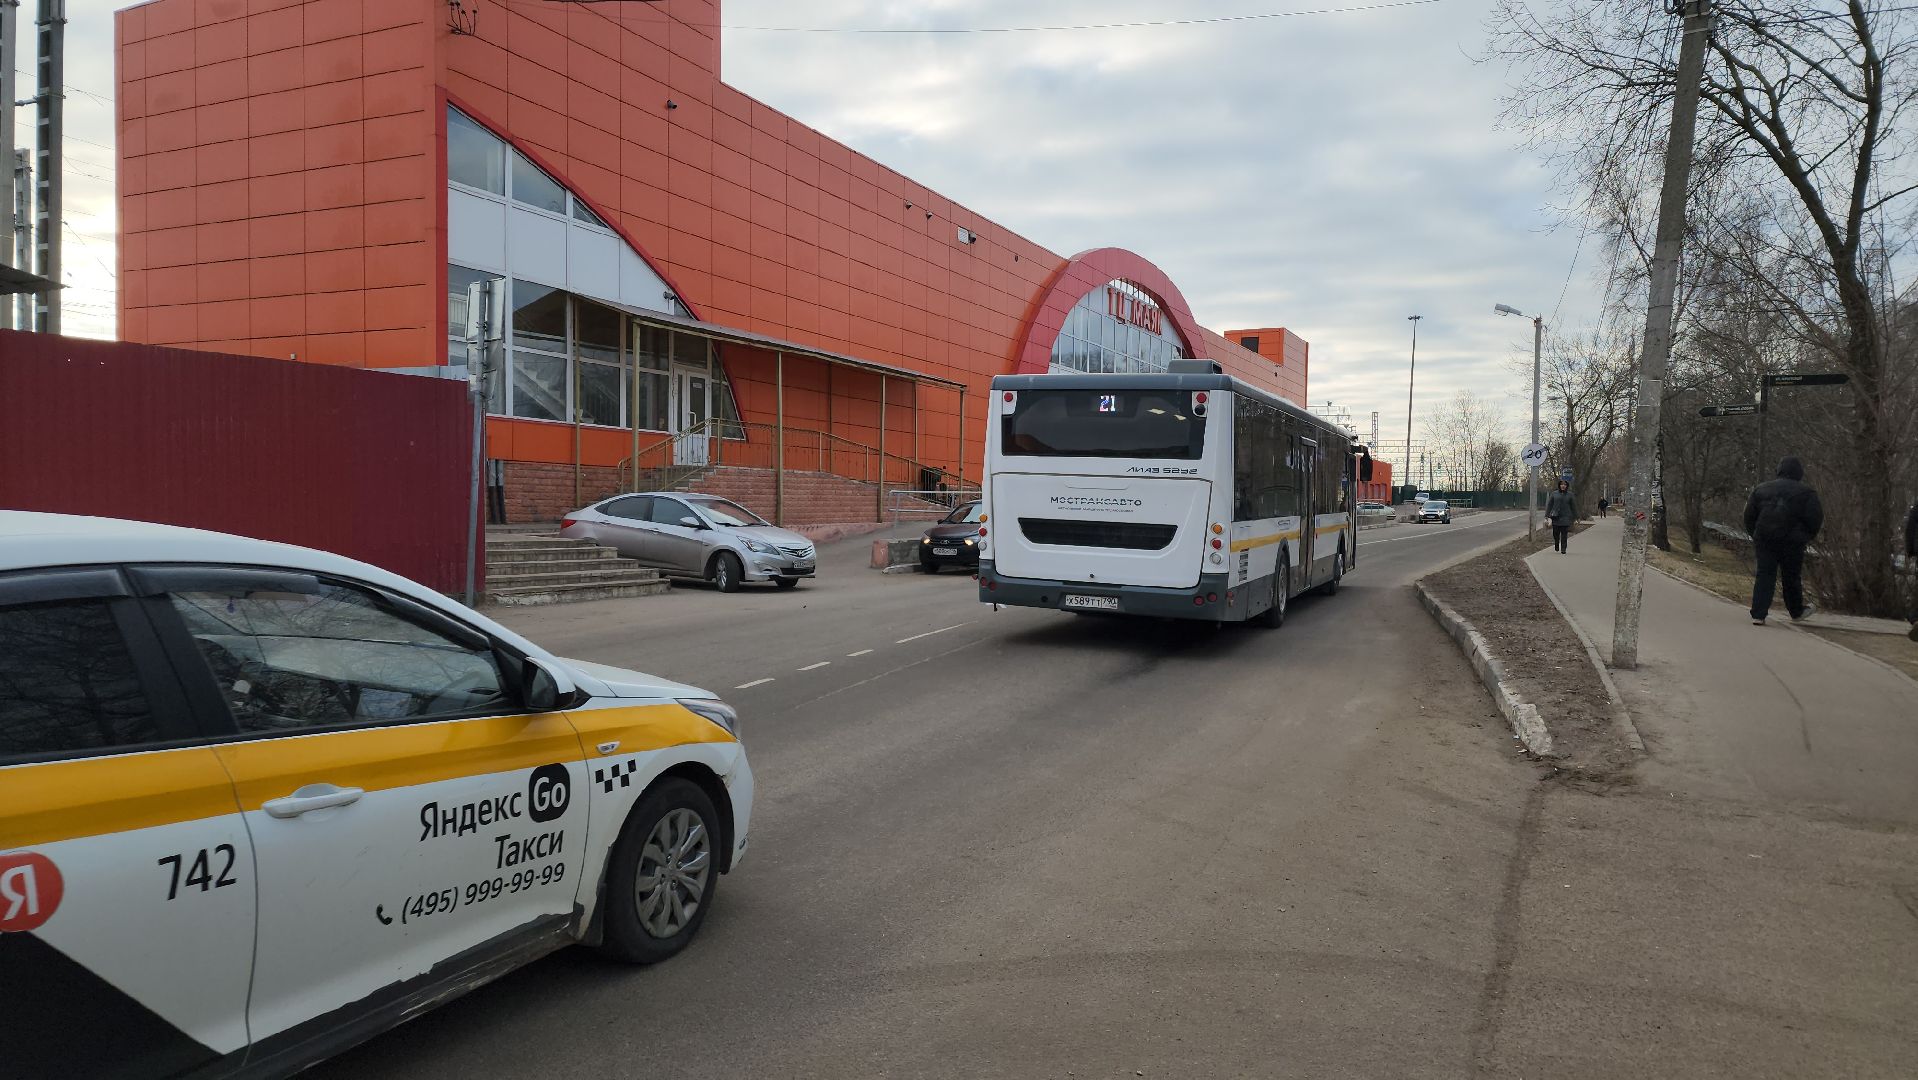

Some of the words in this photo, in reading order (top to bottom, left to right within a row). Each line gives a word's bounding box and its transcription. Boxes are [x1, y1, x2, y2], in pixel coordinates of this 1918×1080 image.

[1100, 395, 1116, 412] 21
[1527, 449, 1542, 459] 20
[1050, 496, 1142, 507] МОСТРАНСАВТО
[419, 791, 522, 843] Яндекс
[533, 776, 567, 812] Go
[158, 843, 238, 901] 742
[495, 829, 564, 869] Такси
[0, 864, 39, 921] Я
[402, 886, 459, 925] (495)
[464, 862, 565, 906] 999-99-99
